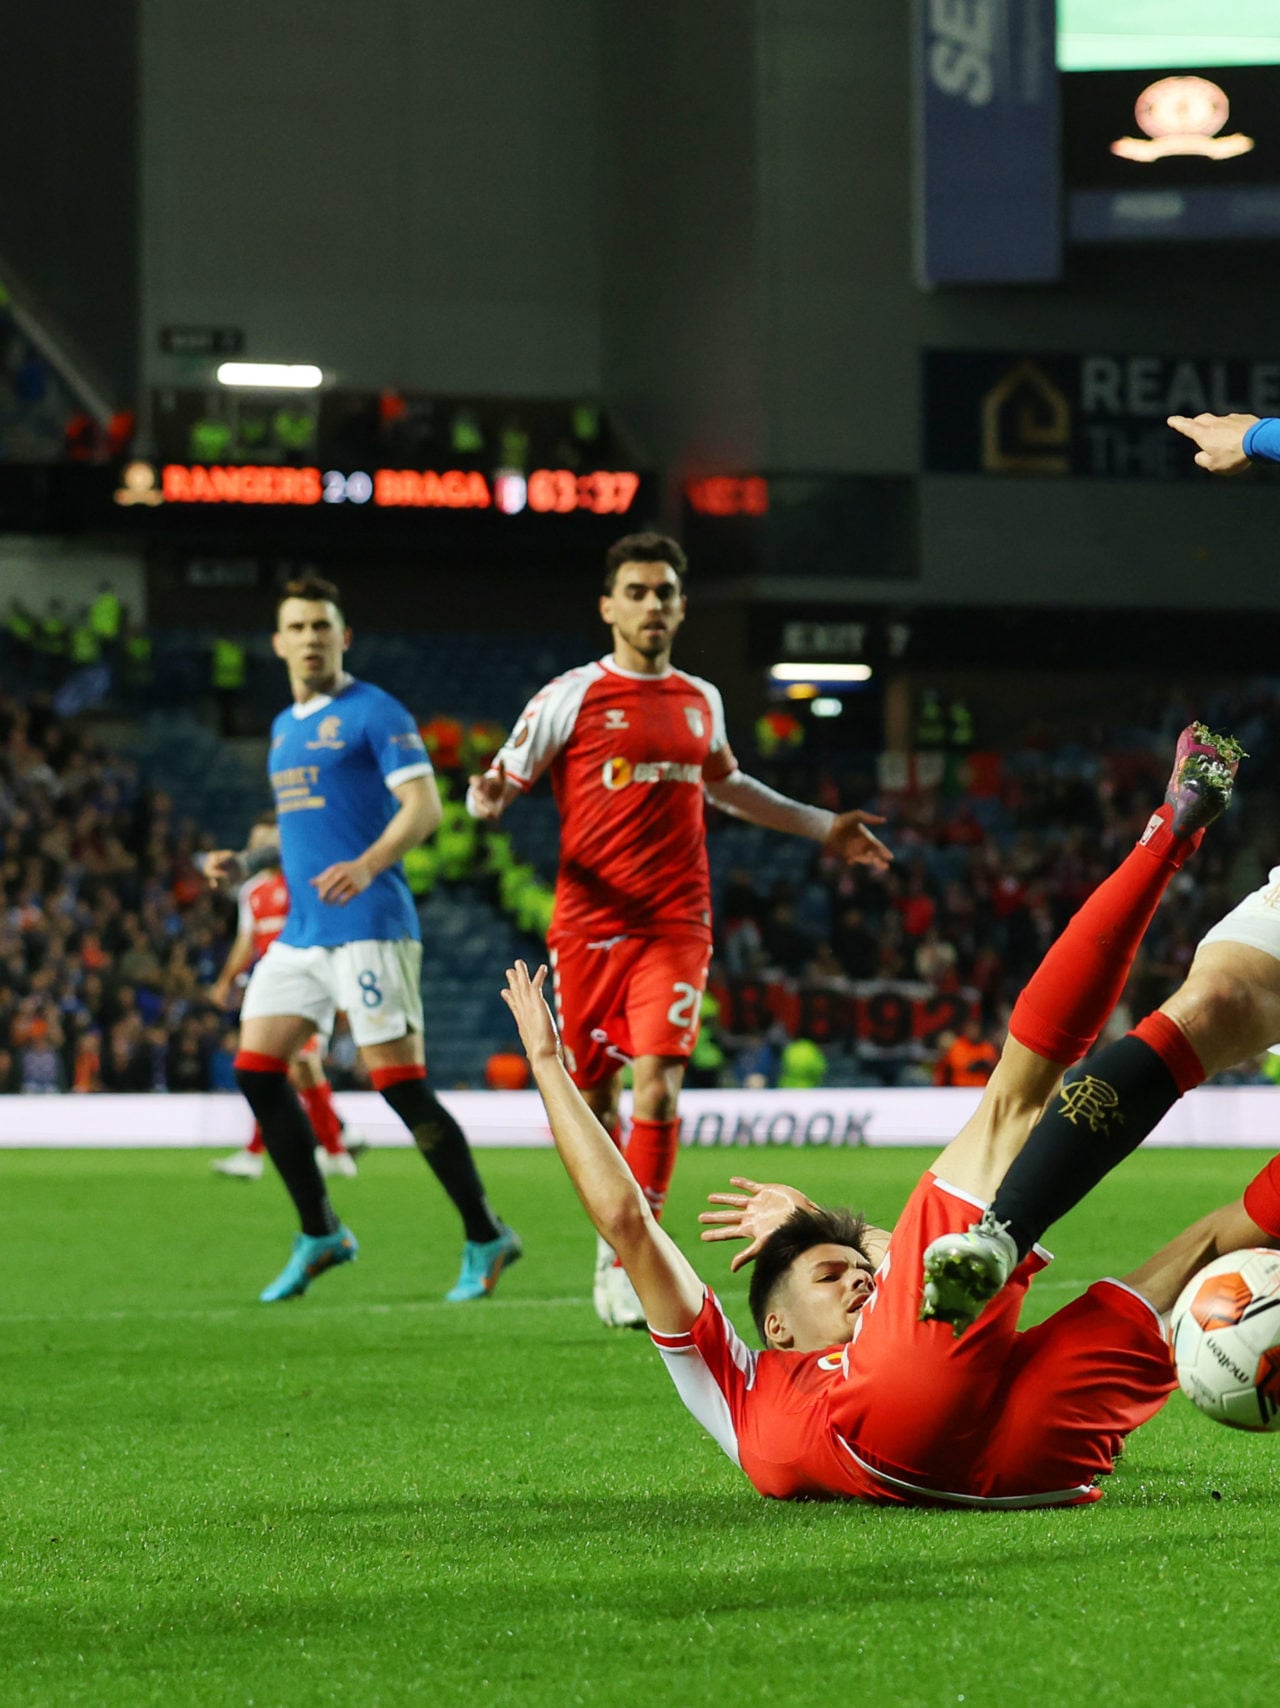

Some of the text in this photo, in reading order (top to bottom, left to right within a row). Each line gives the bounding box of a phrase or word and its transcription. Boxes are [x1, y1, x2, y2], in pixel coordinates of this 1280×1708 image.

[931, 0, 994, 106] SE
[161, 465, 322, 503] RANGERS
[322, 469, 373, 504] 2-0
[374, 468, 491, 508] BRAGA
[357, 969, 382, 1008] 8
[1206, 1337, 1250, 1385] molten
